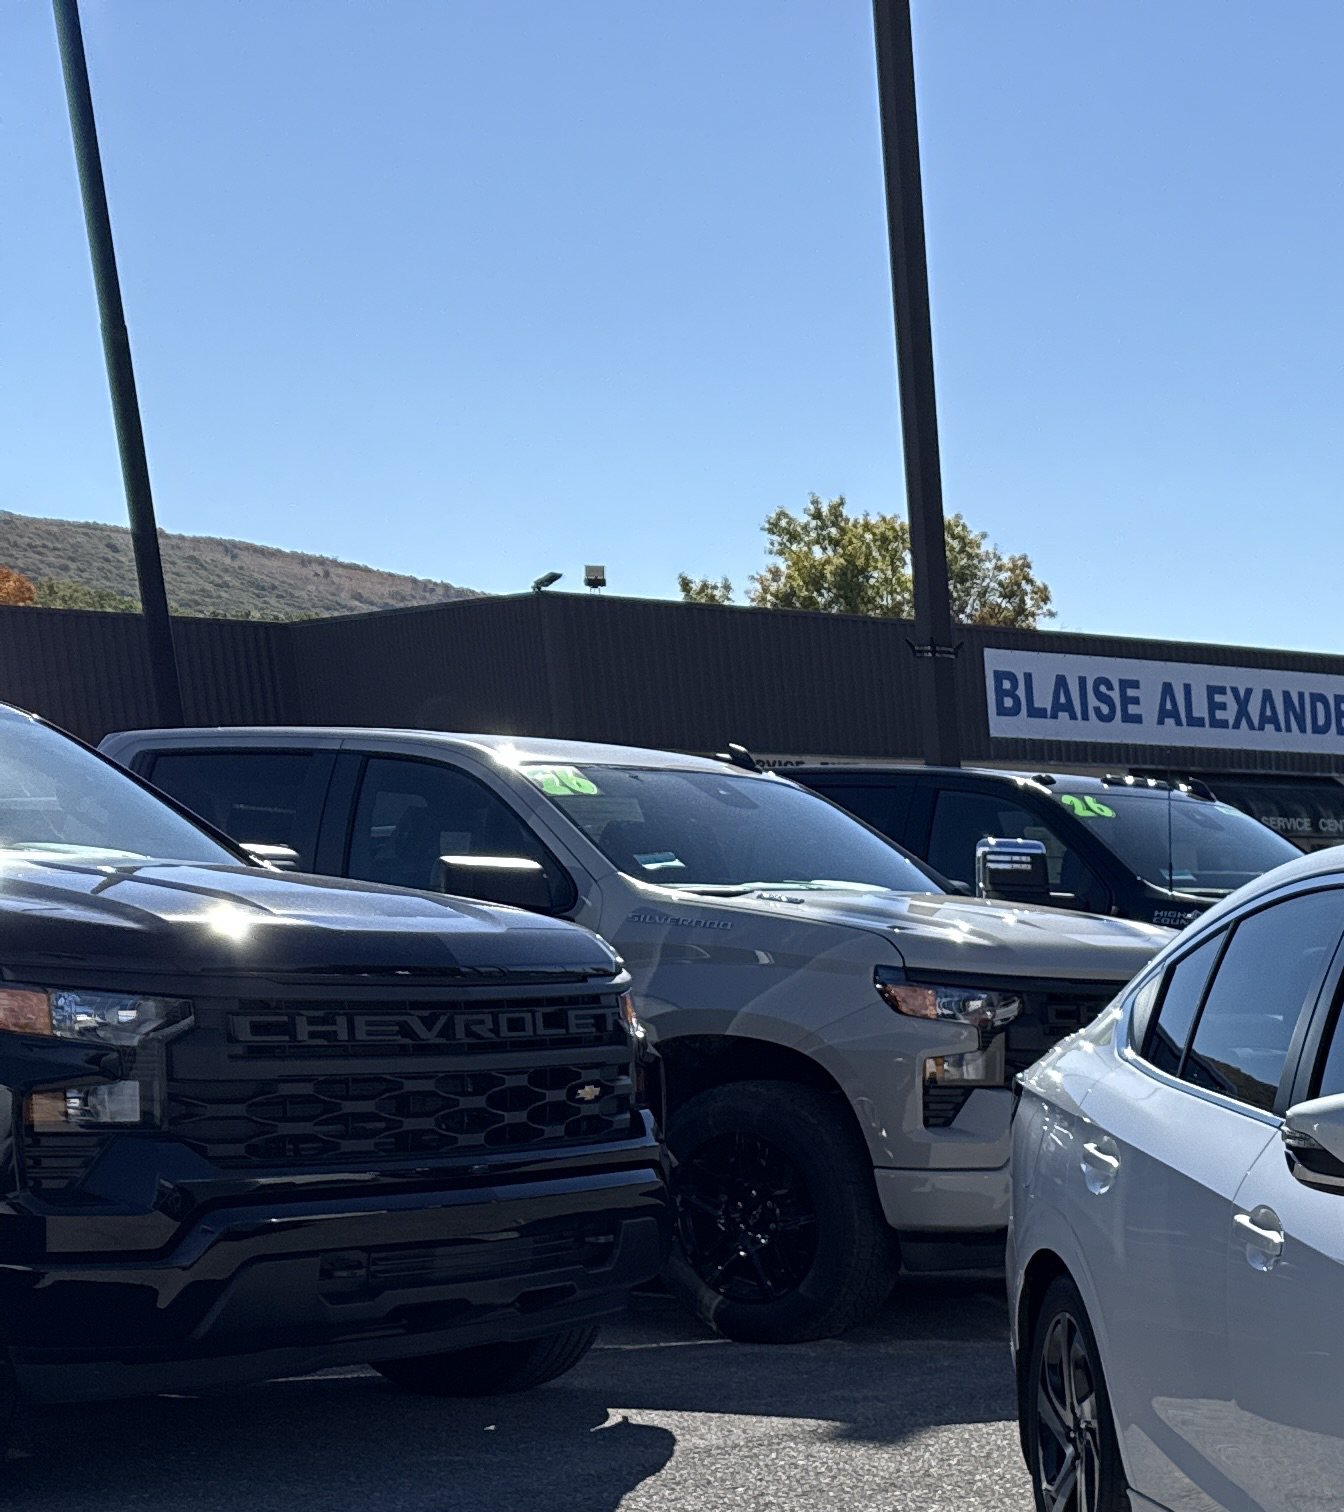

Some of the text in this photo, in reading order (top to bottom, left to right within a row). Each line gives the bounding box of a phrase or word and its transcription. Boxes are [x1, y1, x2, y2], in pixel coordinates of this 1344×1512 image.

[992, 669, 1143, 725] BLAISE
[1061, 794, 1116, 818] 26
[1260, 816, 1312, 831] SERVICE
[627, 912, 734, 931] SILVERADO
[1153, 910, 1187, 919] HIGH
[231, 1008, 619, 1042] CHEVROLET
